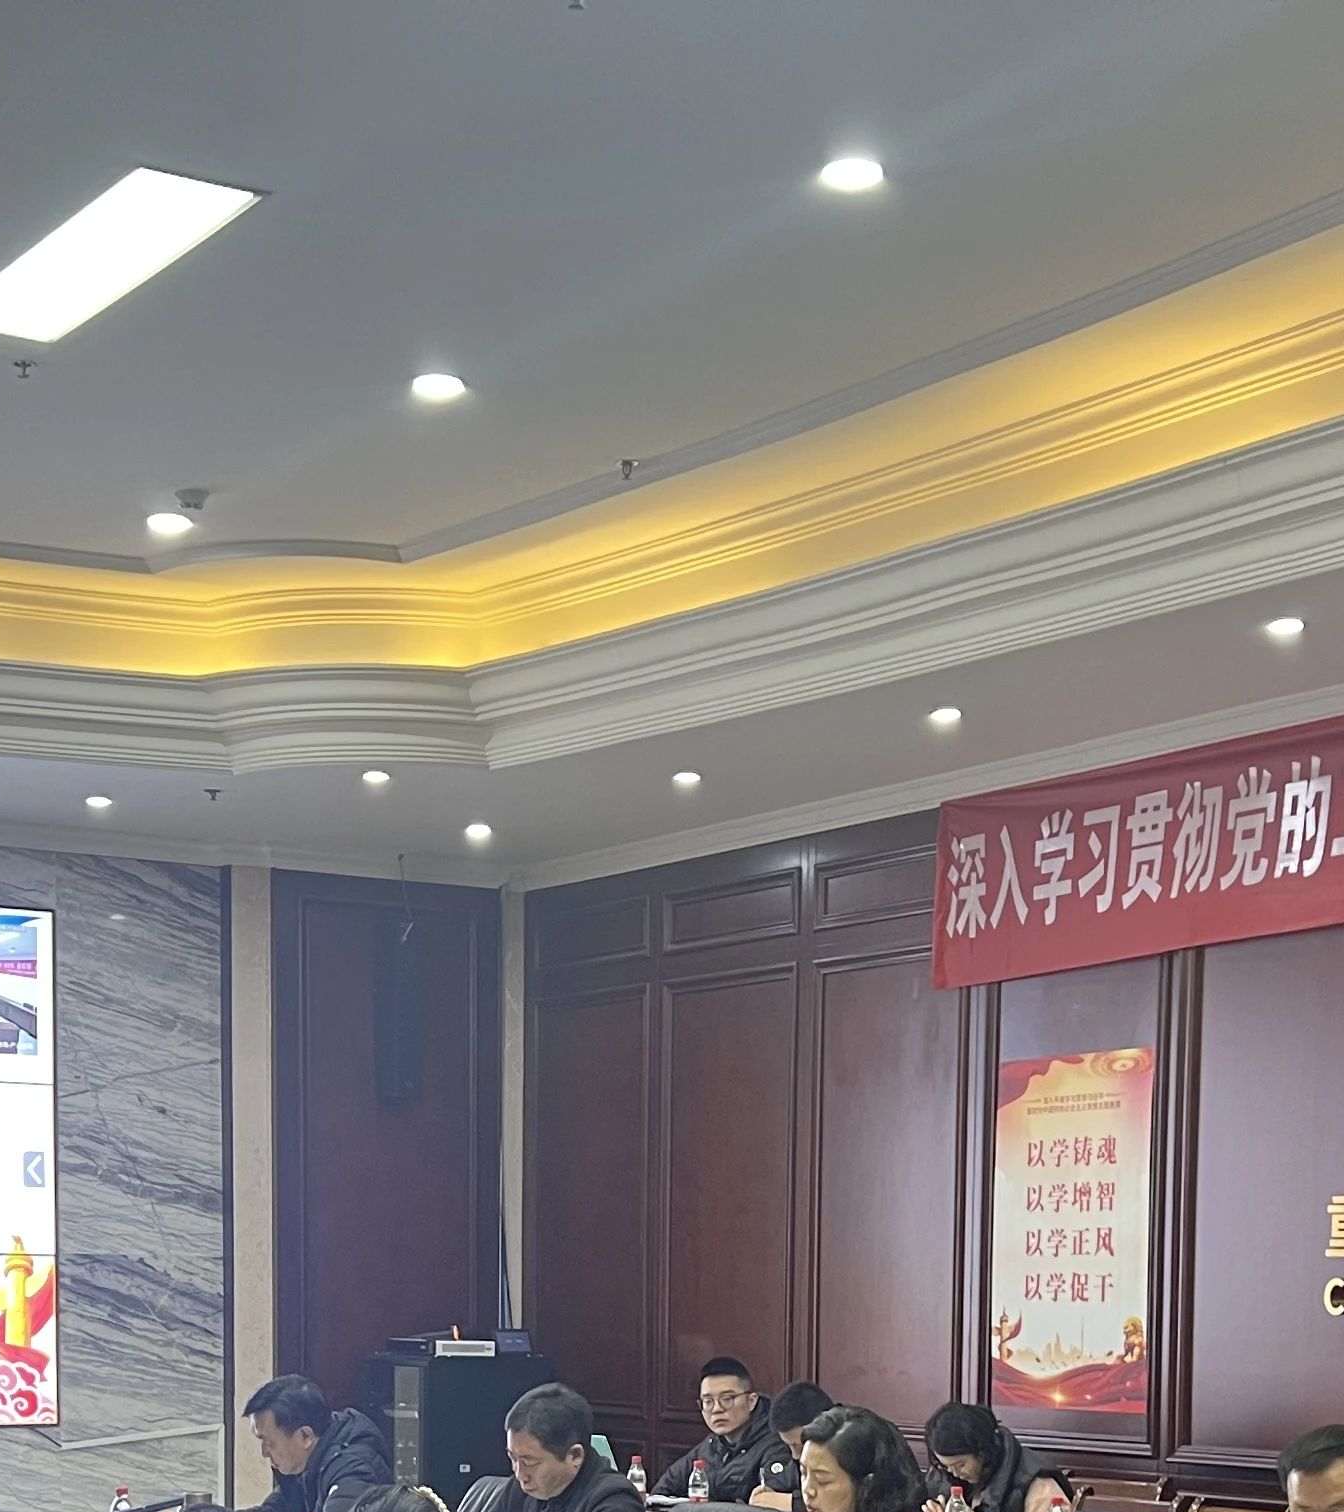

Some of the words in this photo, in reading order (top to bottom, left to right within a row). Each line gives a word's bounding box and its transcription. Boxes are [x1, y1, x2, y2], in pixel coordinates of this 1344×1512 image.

[1026, 1134, 1118, 1168] 以学铸魂
[1025, 1180, 1117, 1213] 以学增智
[1024, 1226, 1115, 1258] 以学正风
[1023, 1271, 1114, 1303] 以学促干
